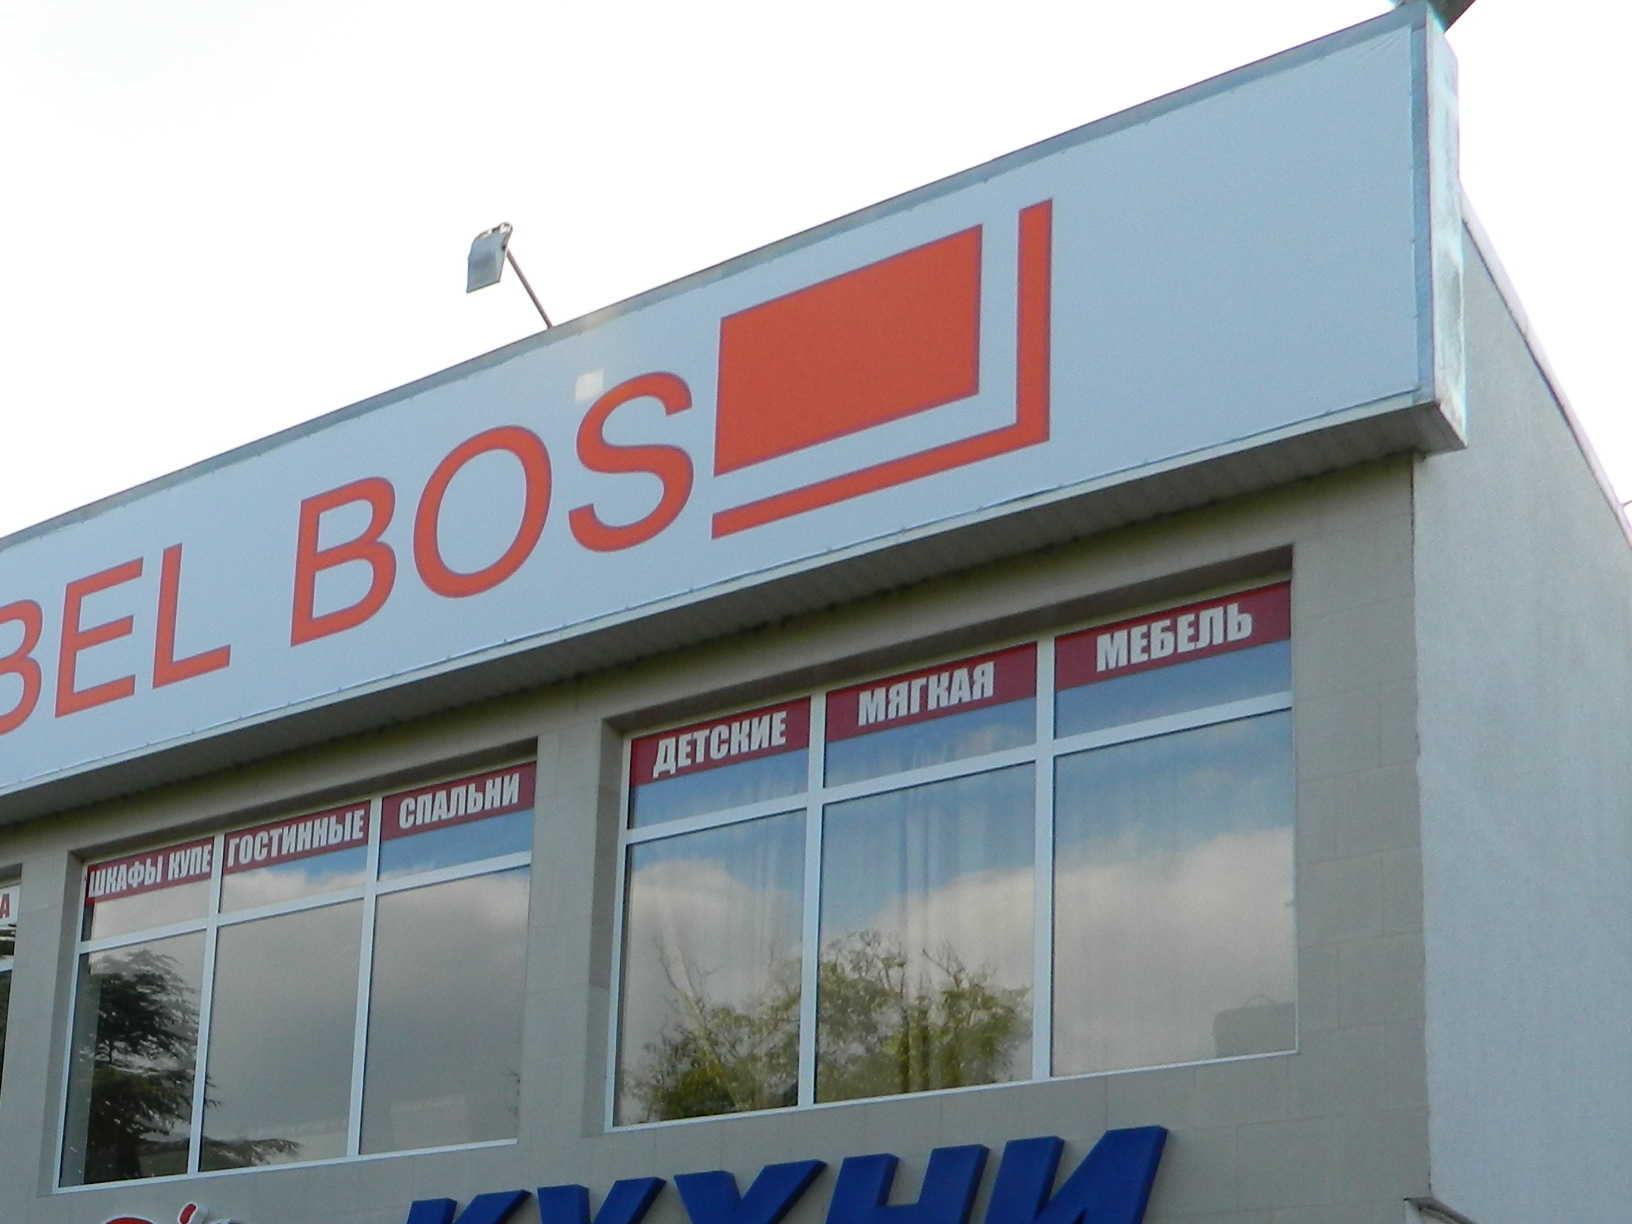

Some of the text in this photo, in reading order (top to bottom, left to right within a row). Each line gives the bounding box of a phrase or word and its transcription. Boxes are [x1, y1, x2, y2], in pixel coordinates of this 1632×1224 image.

[289, 370, 694, 648] BOS
[856, 603, 1254, 728] МЯГКАЯ МЕБЕЛЬ
[651, 710, 787, 779] ДЕТСКИЕ
[398, 772, 521, 830] СПАЛЬНИ
[226, 807, 367, 869] ГОСТИННЫЕ
[88, 843, 213, 899] ШКАФЫ КУПЕ
